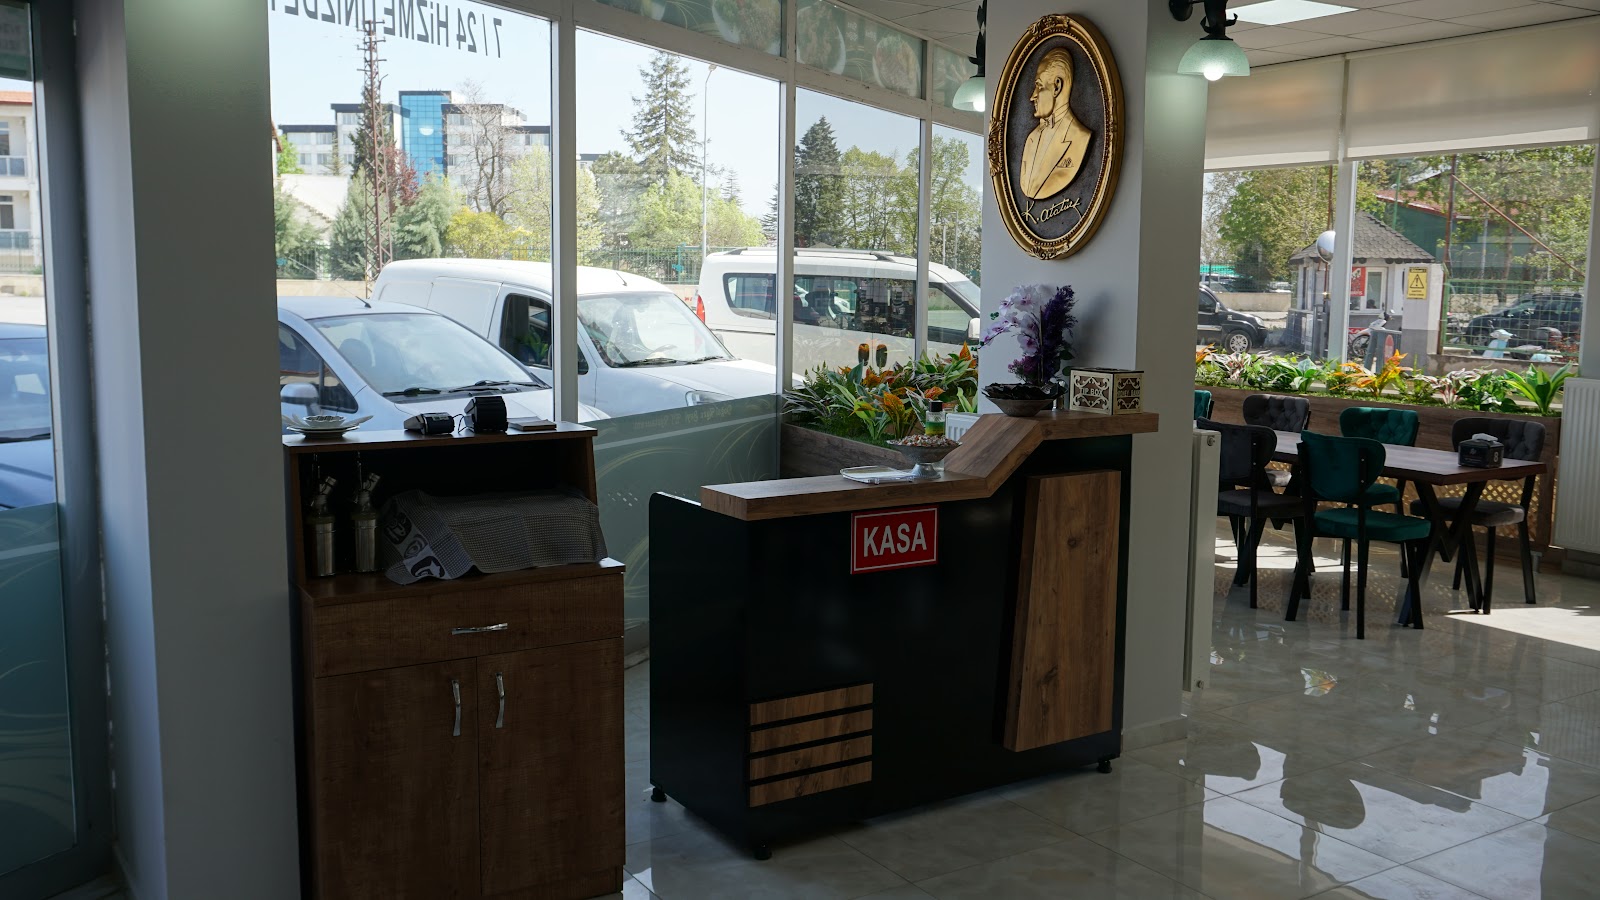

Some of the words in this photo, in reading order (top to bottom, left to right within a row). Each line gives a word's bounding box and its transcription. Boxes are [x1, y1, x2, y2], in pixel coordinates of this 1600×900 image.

[1091, 388, 1102, 396] BOX
[1493, 451, 1499, 463] 8
[864, 522, 927, 557] KASA
